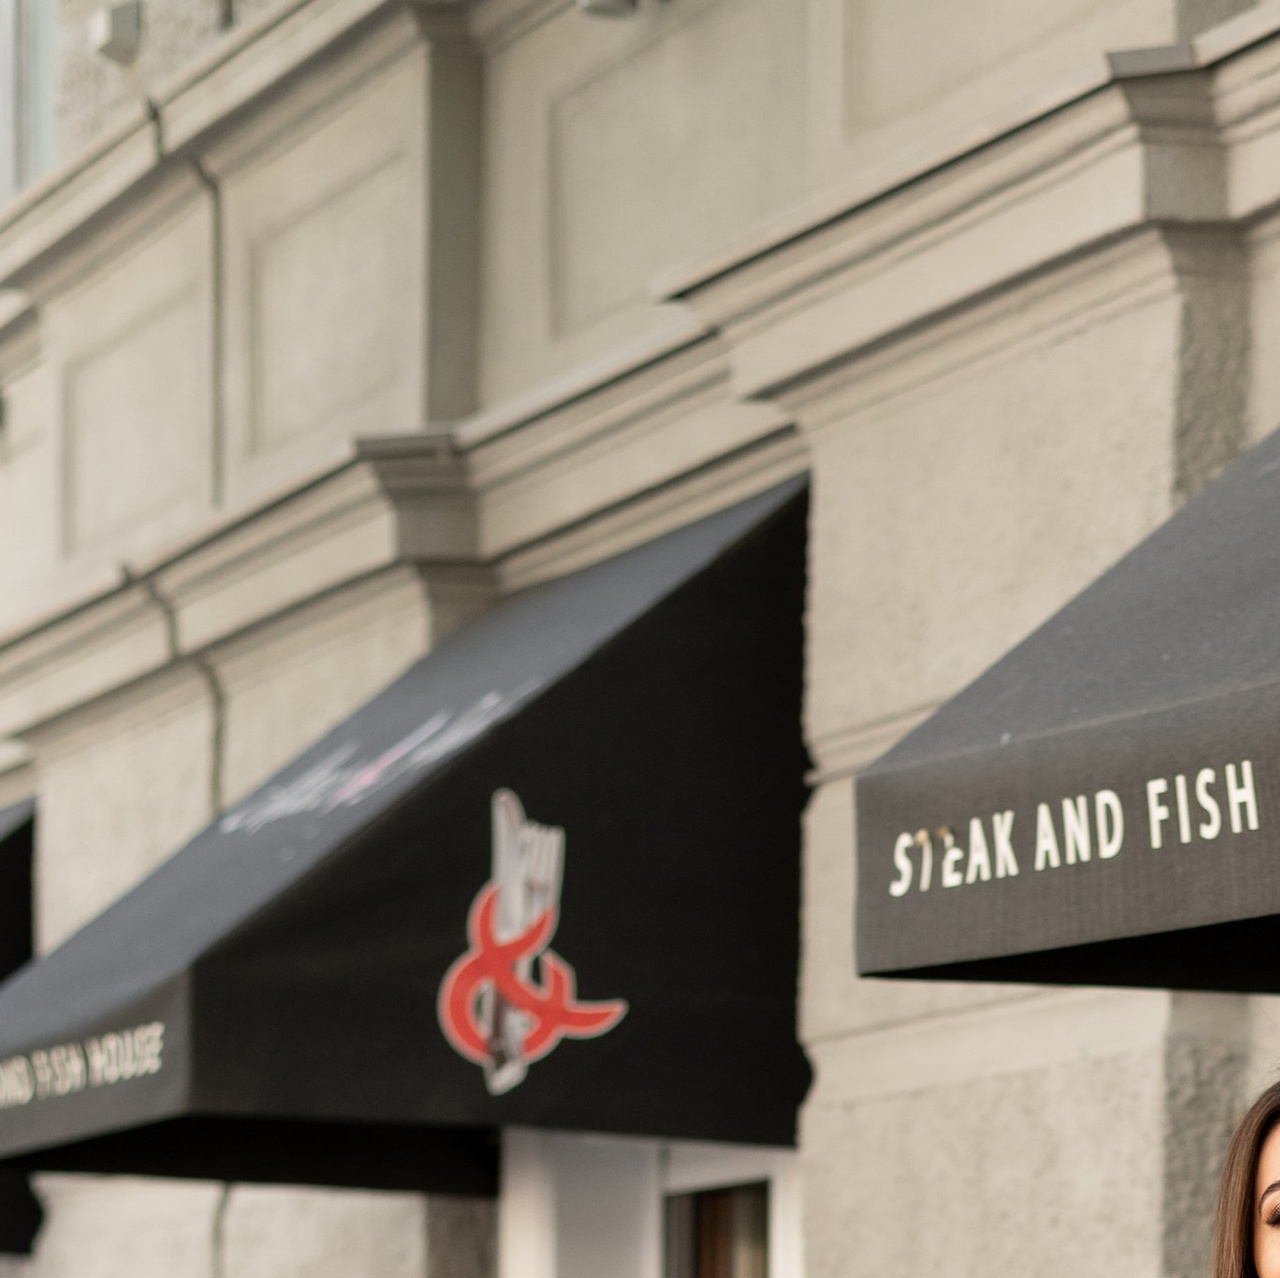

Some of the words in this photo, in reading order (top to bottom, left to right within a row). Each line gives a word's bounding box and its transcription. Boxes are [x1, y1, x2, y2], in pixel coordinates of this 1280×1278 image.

[889, 809, 1019, 898] STEAK
[1034, 789, 1125, 872] AND
[1146, 760, 1259, 849] FISH
[85, 1021, 165, 1087] HOUSE
